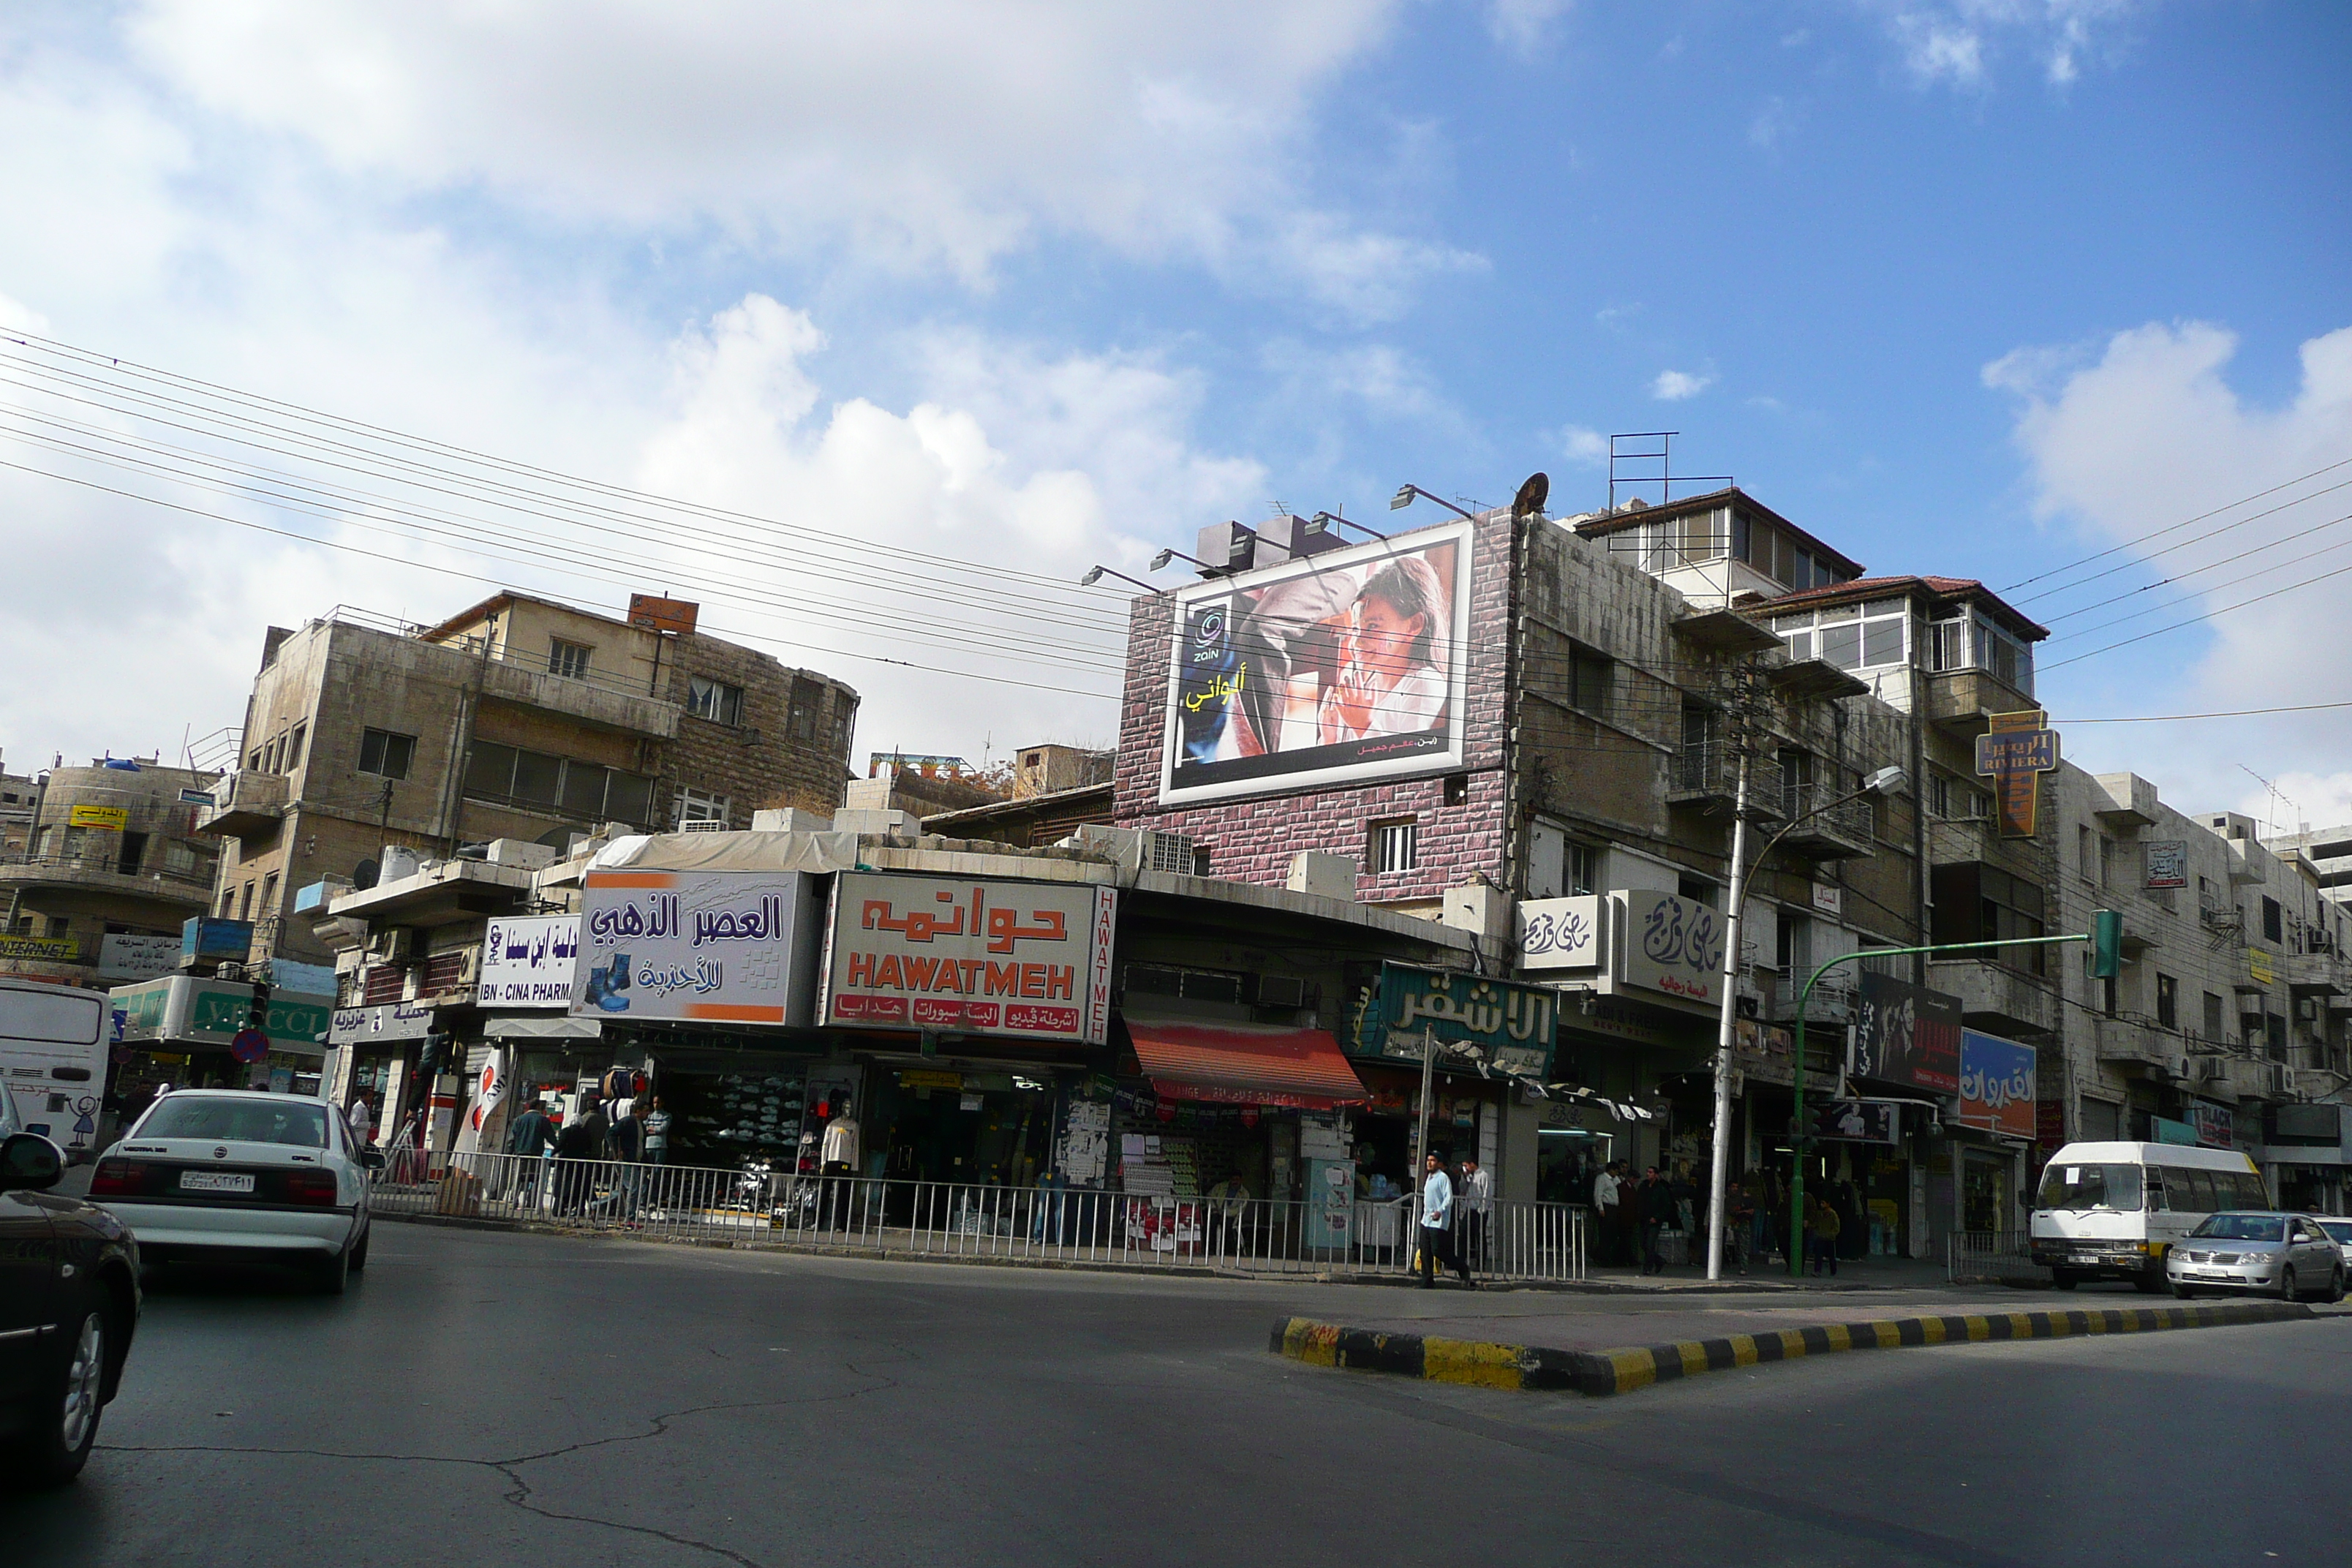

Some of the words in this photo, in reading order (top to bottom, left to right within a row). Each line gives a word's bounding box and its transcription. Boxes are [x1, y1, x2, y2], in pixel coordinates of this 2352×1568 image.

[1194, 648, 1219, 663] zain
[1186, 662, 1247, 713] ألواني
[1357, 745, 1388, 755] جميل
[1984, 755, 2048, 769] RIVIERA
[77, 807, 123, 818] الدولي
[589, 892, 679, 946] الذهبي
[691, 893, 783, 948] العصر
[862, 886, 1067, 954] حواتمه
[505, 927, 530, 968] سينا
[552, 924, 578, 968] دلية
[637, 955, 723, 997] للأحذية
[847, 951, 1076, 1000] HAWATMEH
[1090, 890, 1113, 1041] HAWATMEH
[480, 984, 498, 1000] IBN
[505, 984, 529, 1000] CINA
[916, 1000, 961, 1022] سبورات
[206, 999, 320, 1034] VICCI
[1039, 1009, 1078, 1028] أشرطة
[2201, 1105, 2231, 1128] BLACK
